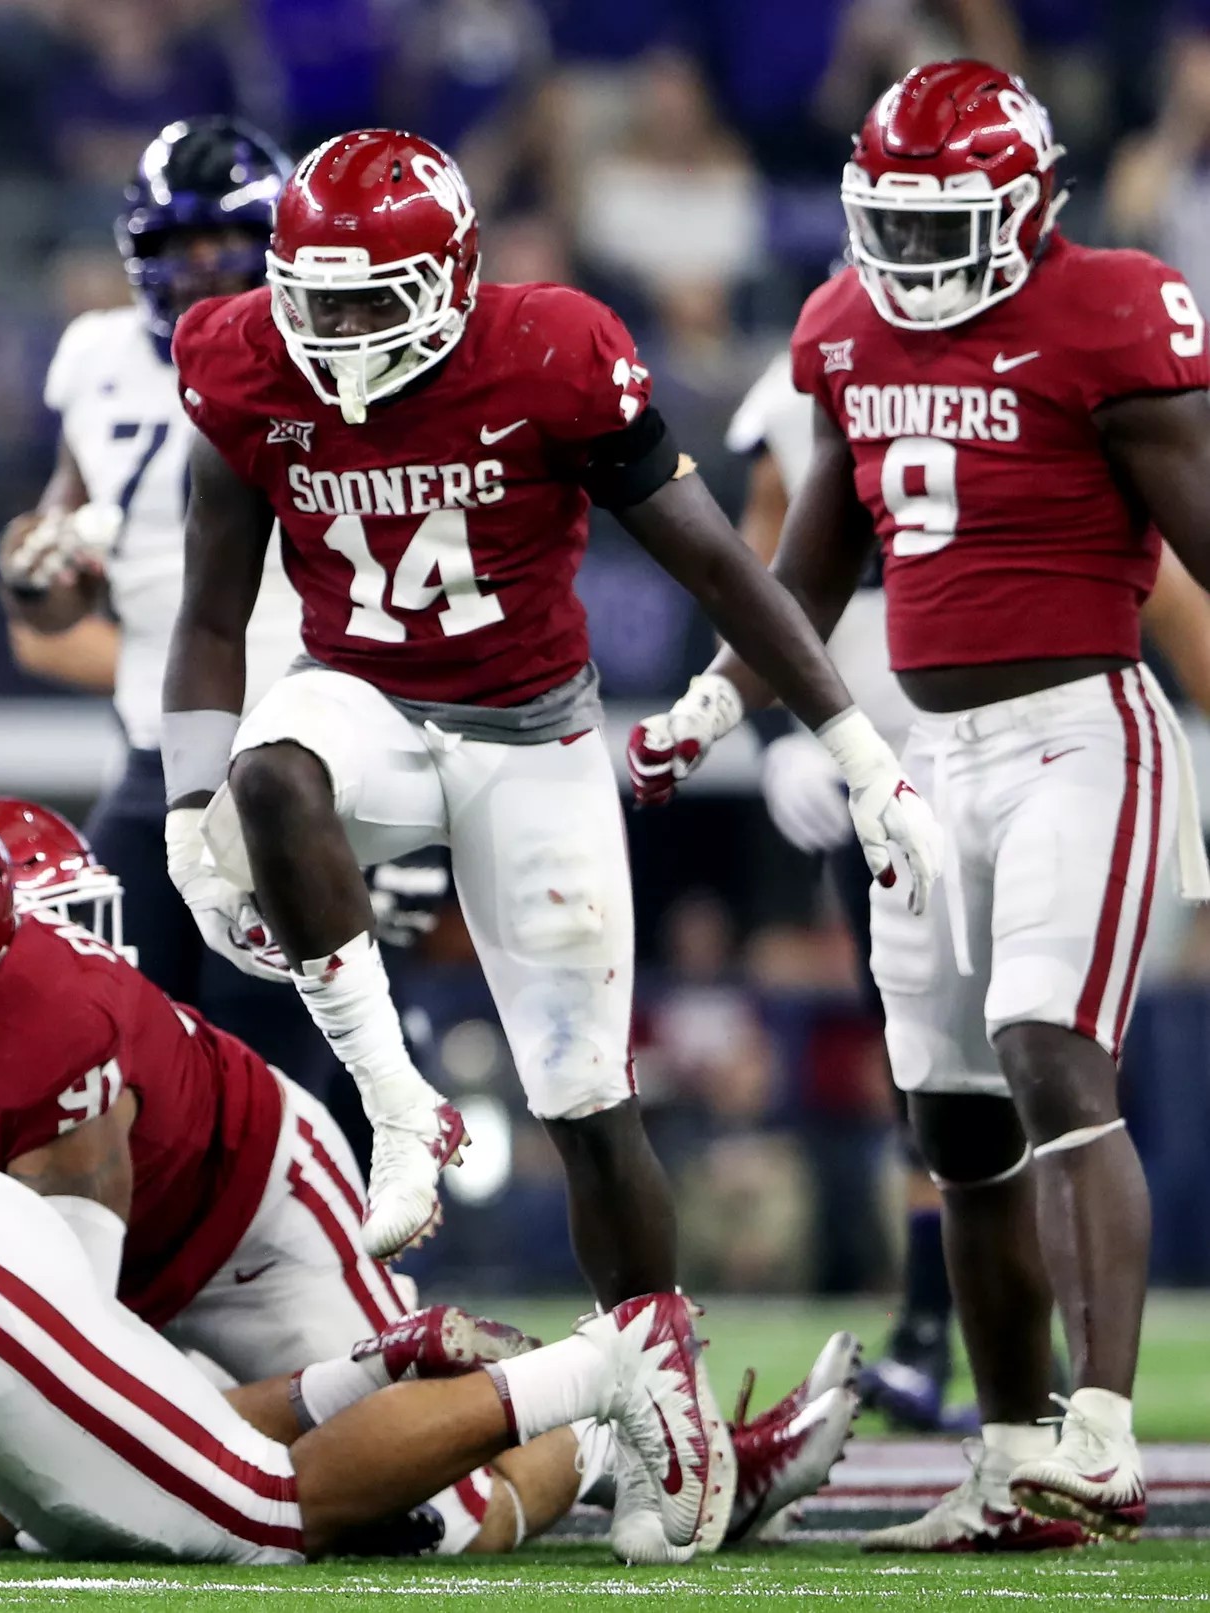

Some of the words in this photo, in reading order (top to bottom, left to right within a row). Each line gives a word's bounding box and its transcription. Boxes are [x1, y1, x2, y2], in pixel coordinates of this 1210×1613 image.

[1159, 281, 1205, 357] 9
[844, 384, 1020, 442] SOONERS
[288, 459, 504, 515] SOONERS
[881, 437, 958, 557] 9
[323, 509, 505, 643] 14
